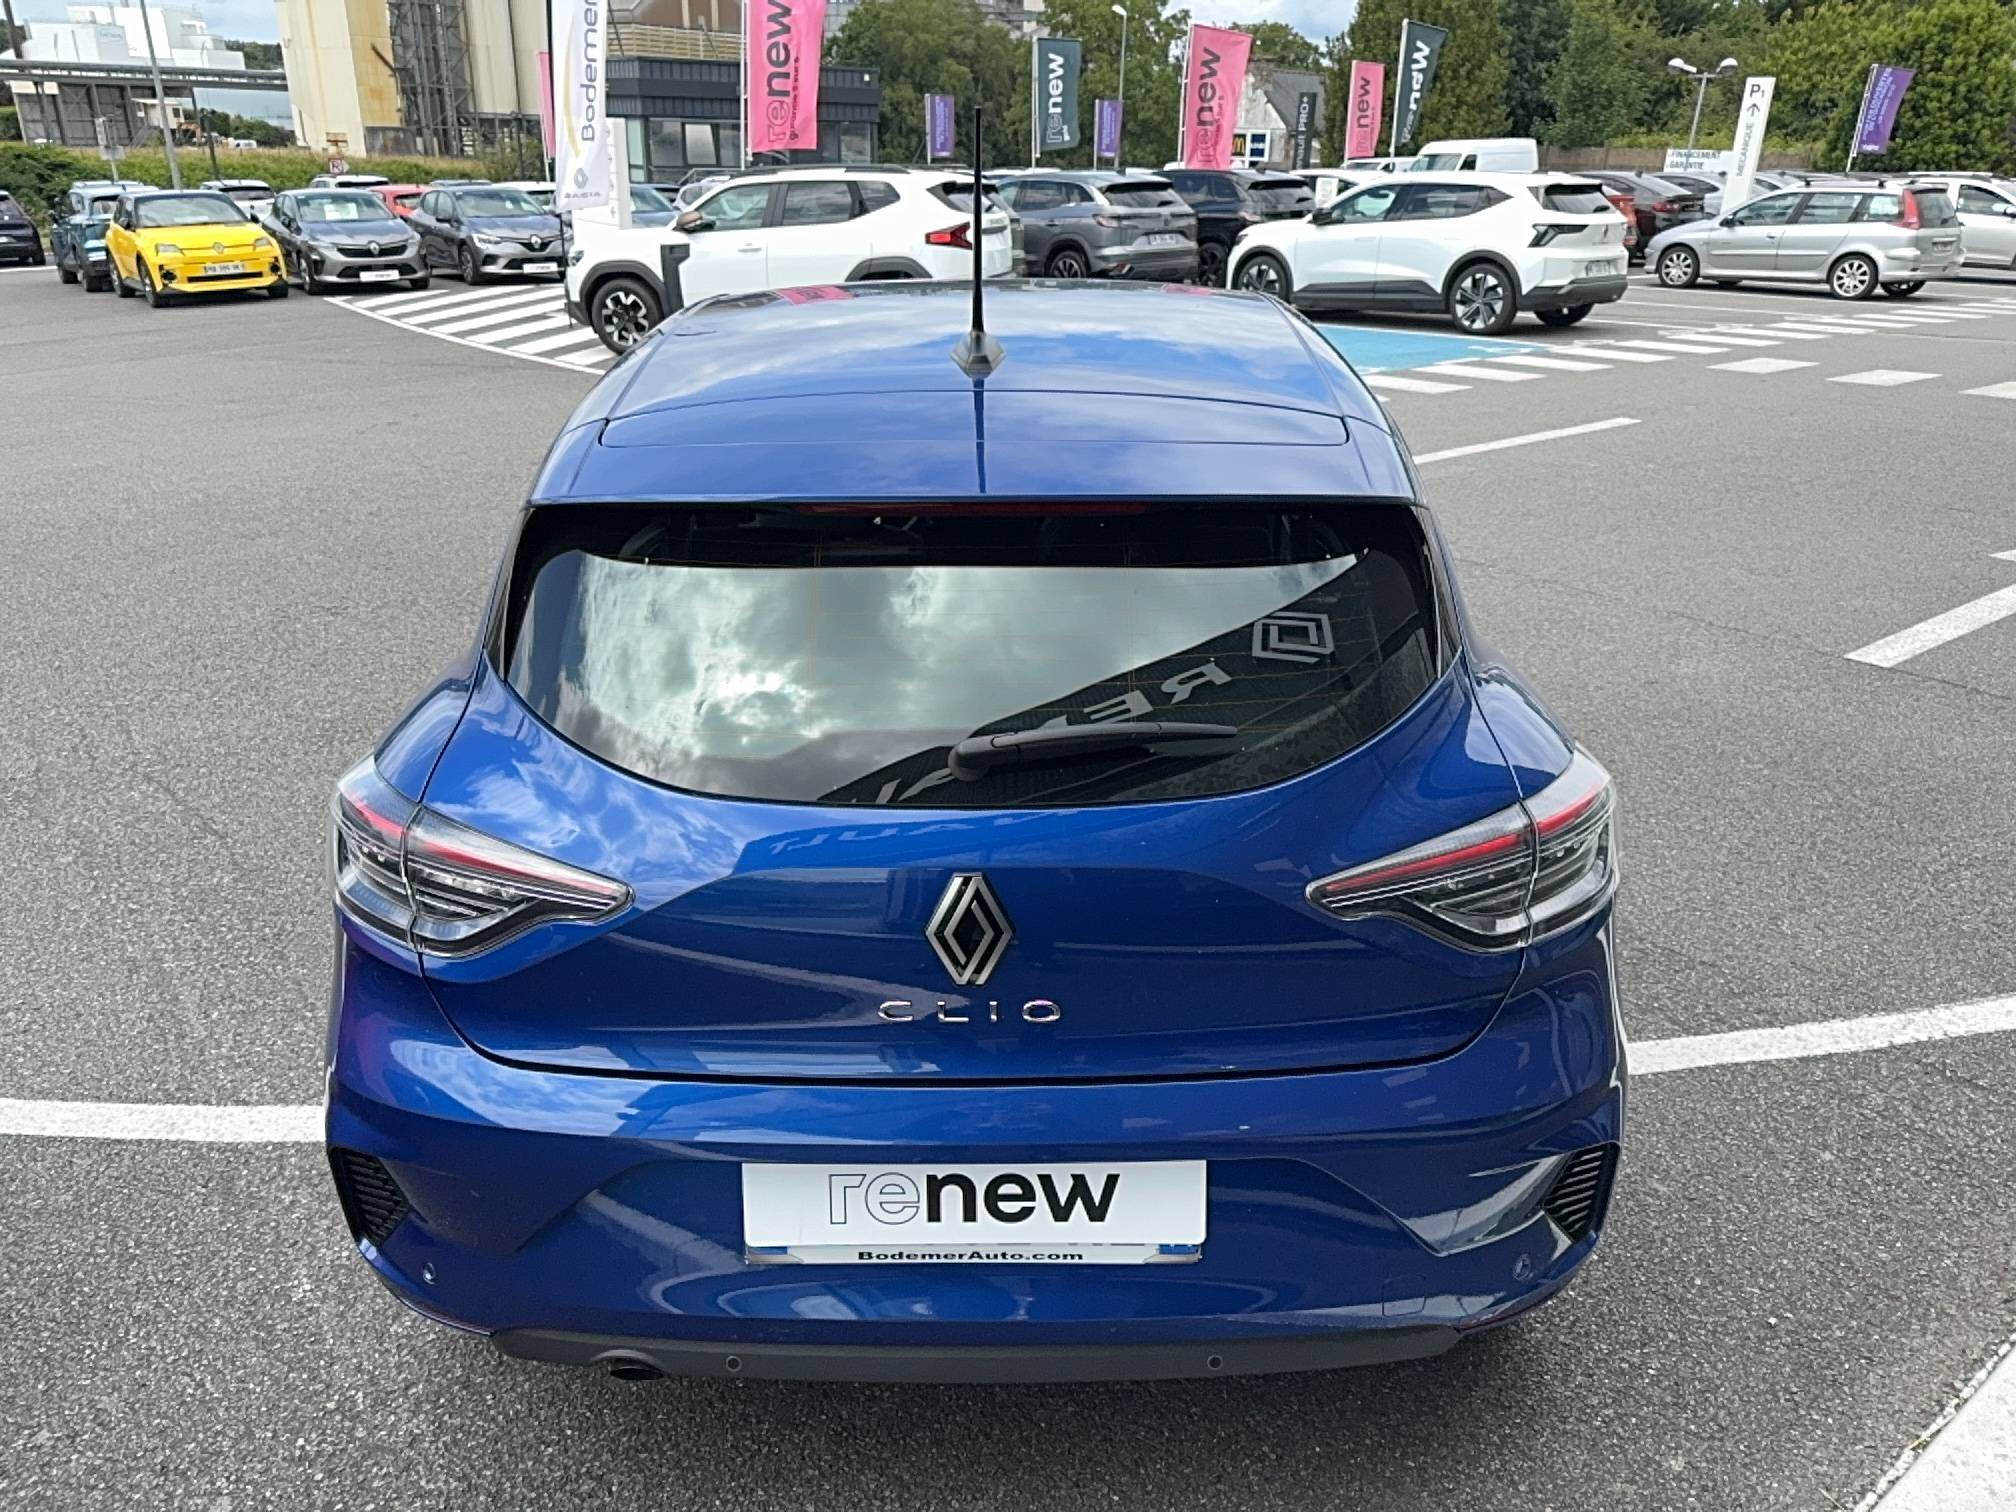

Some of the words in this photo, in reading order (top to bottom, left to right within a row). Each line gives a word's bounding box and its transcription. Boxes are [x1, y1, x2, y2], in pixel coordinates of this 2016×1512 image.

[766, 0, 792, 142] renew
[877, 1000, 1062, 1023] CLIO
[828, 1172, 1121, 1225] renew
[857, 1251, 1084, 1261] BodemerAuto.com
